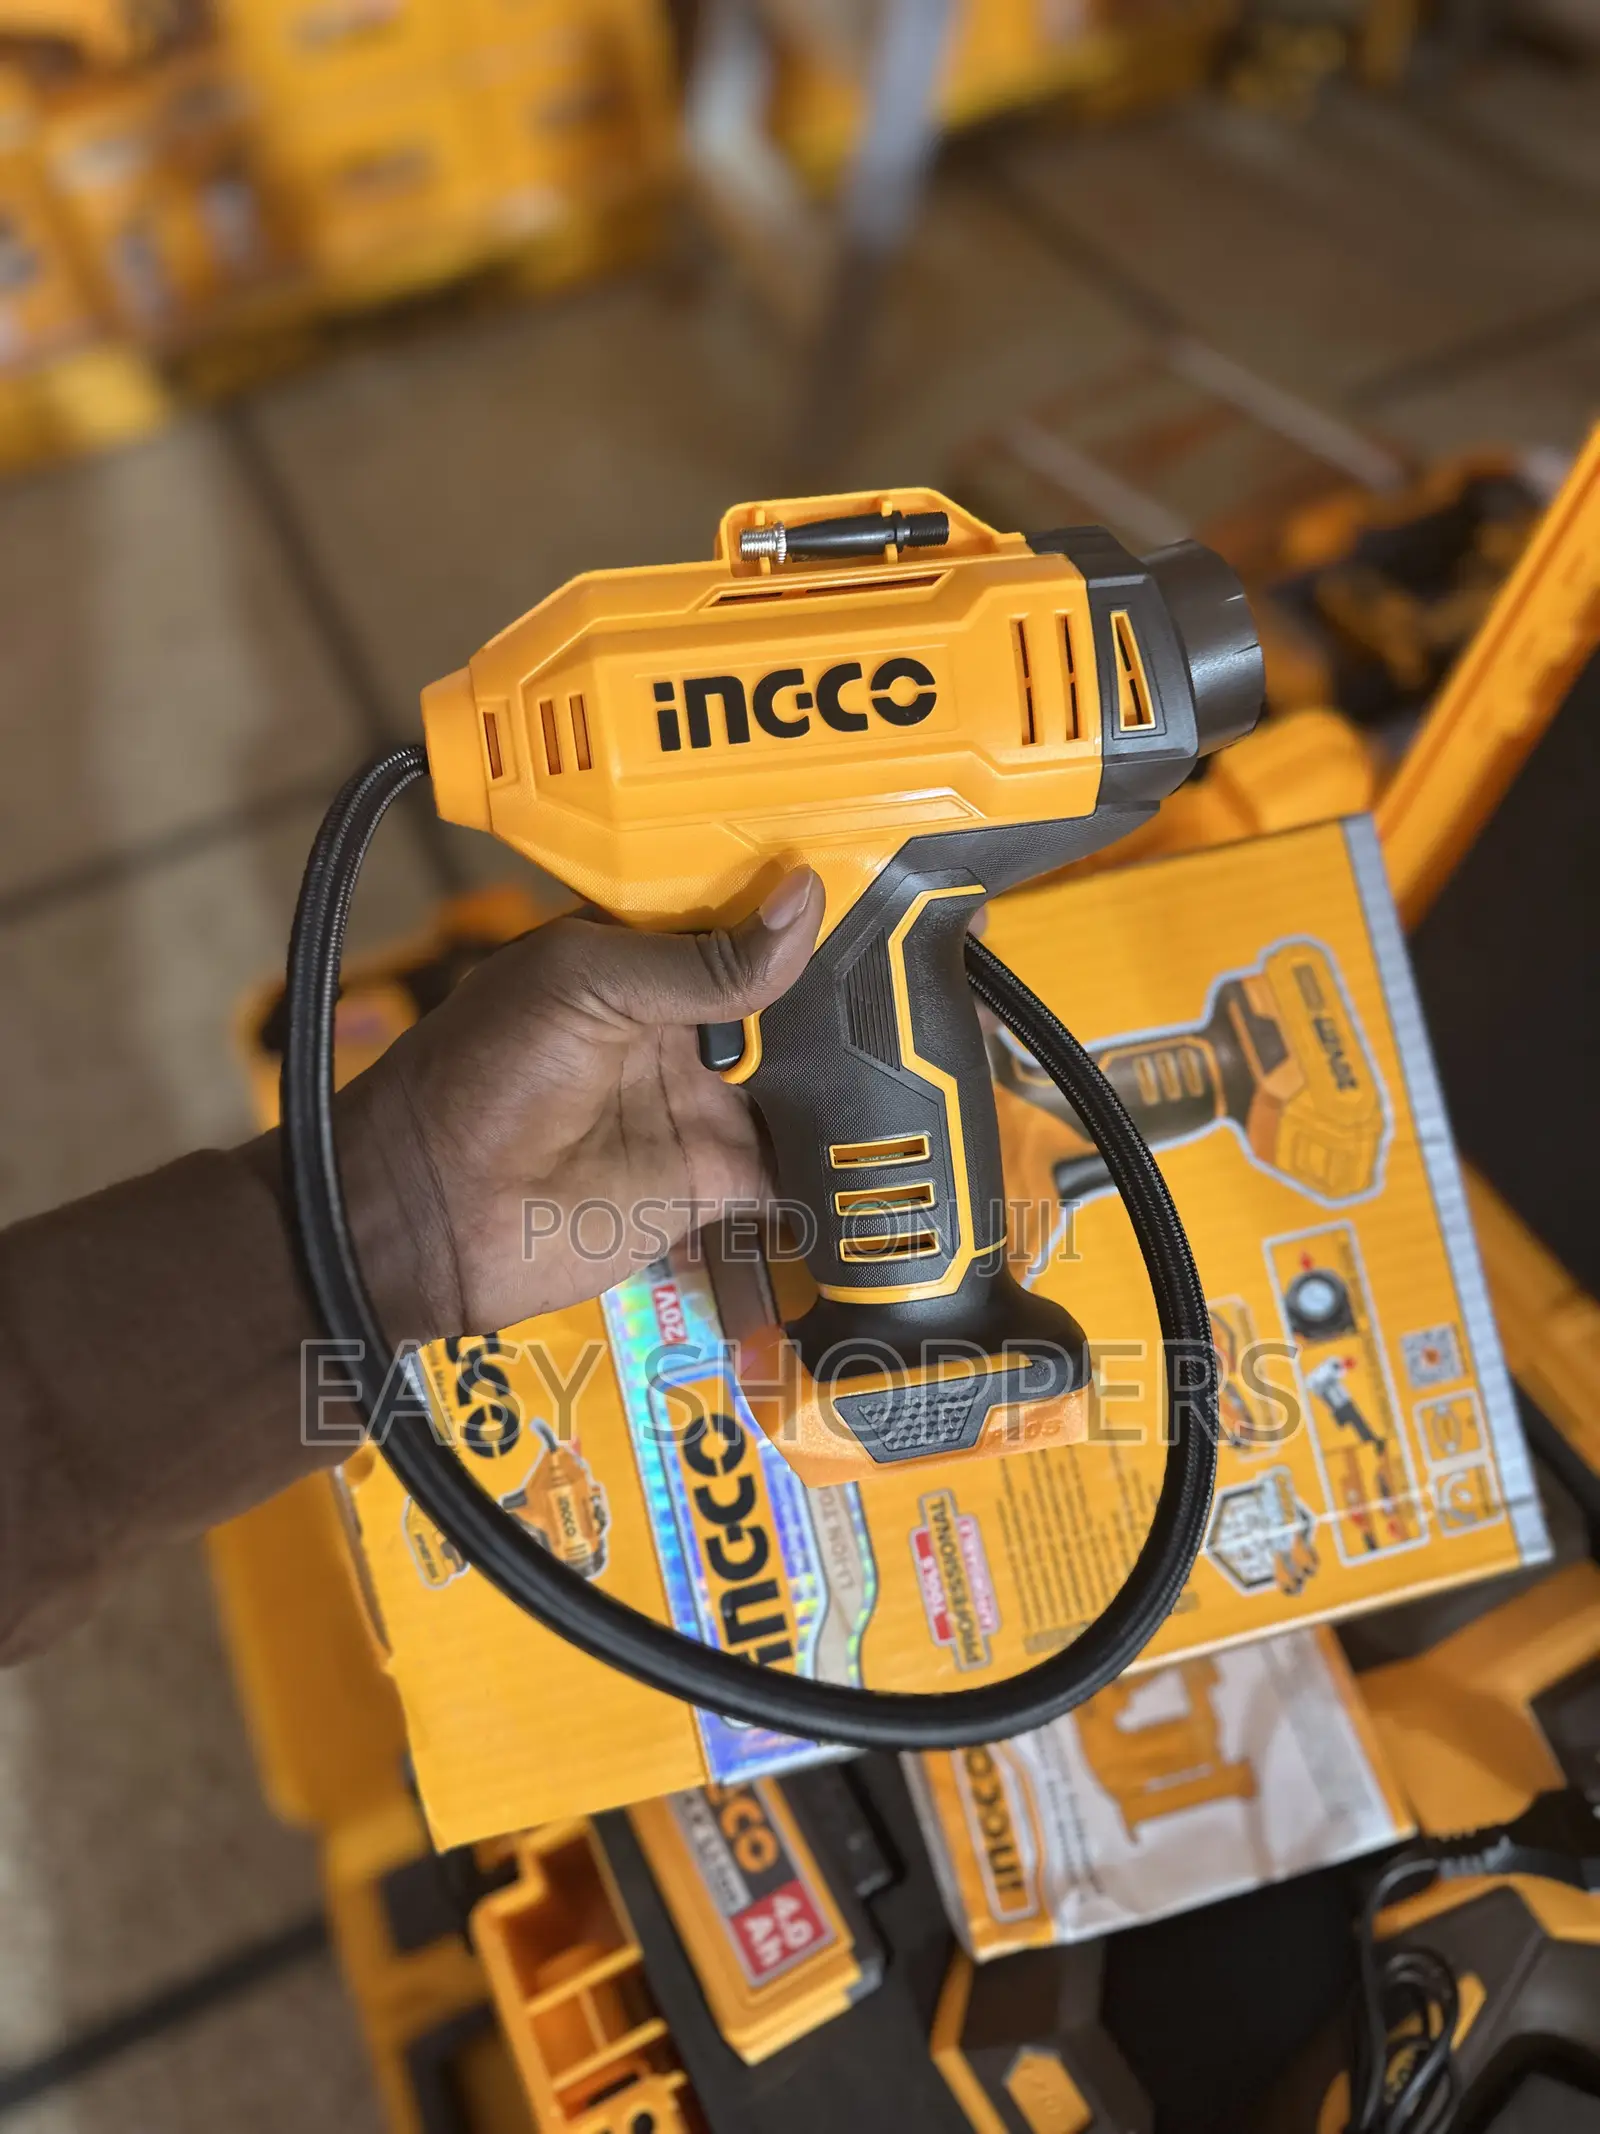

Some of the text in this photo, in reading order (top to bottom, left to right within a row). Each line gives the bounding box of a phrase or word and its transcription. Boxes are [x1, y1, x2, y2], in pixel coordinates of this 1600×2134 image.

[653, 657, 938, 752] INGCO
[654, 1290, 686, 1342] 20V
[444, 1331, 521, 1459] GCO
[928, 1497, 983, 1665] PROFESSIONAL
